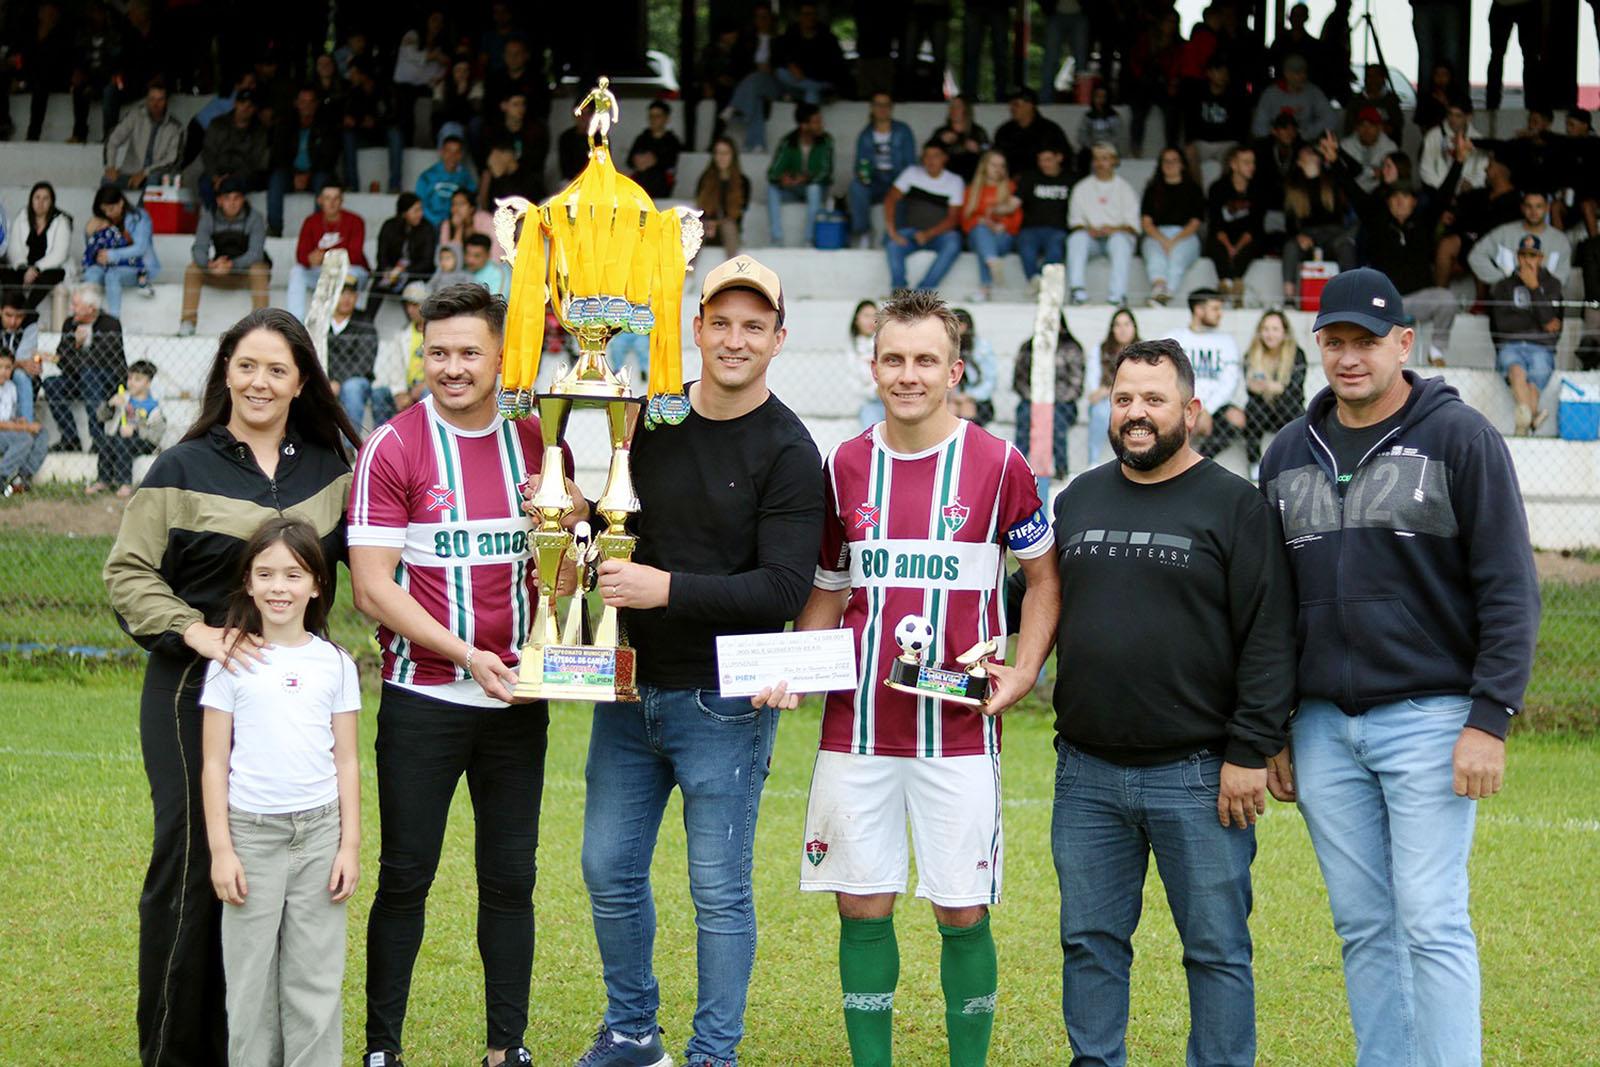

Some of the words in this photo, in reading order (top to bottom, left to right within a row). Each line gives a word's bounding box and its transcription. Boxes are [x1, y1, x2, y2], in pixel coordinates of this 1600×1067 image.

[434, 530, 470, 558] 80
[1008, 520, 1036, 541] FIFA
[861, 548, 889, 578] 80
[895, 553, 959, 580] anos
